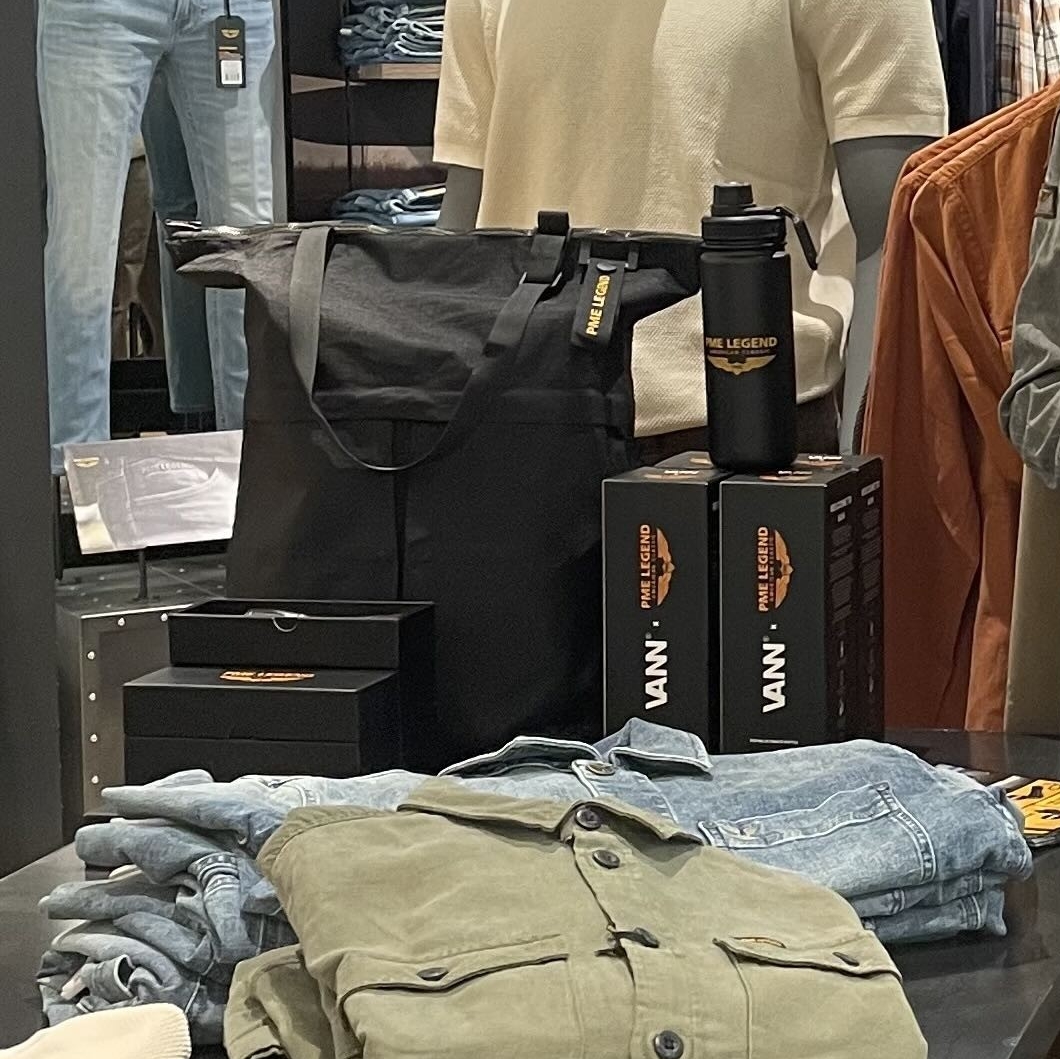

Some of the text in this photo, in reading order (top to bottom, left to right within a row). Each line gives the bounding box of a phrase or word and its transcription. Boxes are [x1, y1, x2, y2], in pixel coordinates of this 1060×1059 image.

[585, 275, 611, 336] PME LEGEND
[726, 336, 778, 349] LEGEND
[640, 524, 651, 577] LEGEND
[757, 526, 769, 580] LEGEND
[640, 580, 651, 609] PME
[758, 582, 769, 612] PME
[644, 640, 668, 710] VANN
[762, 642, 786, 713] VANN
